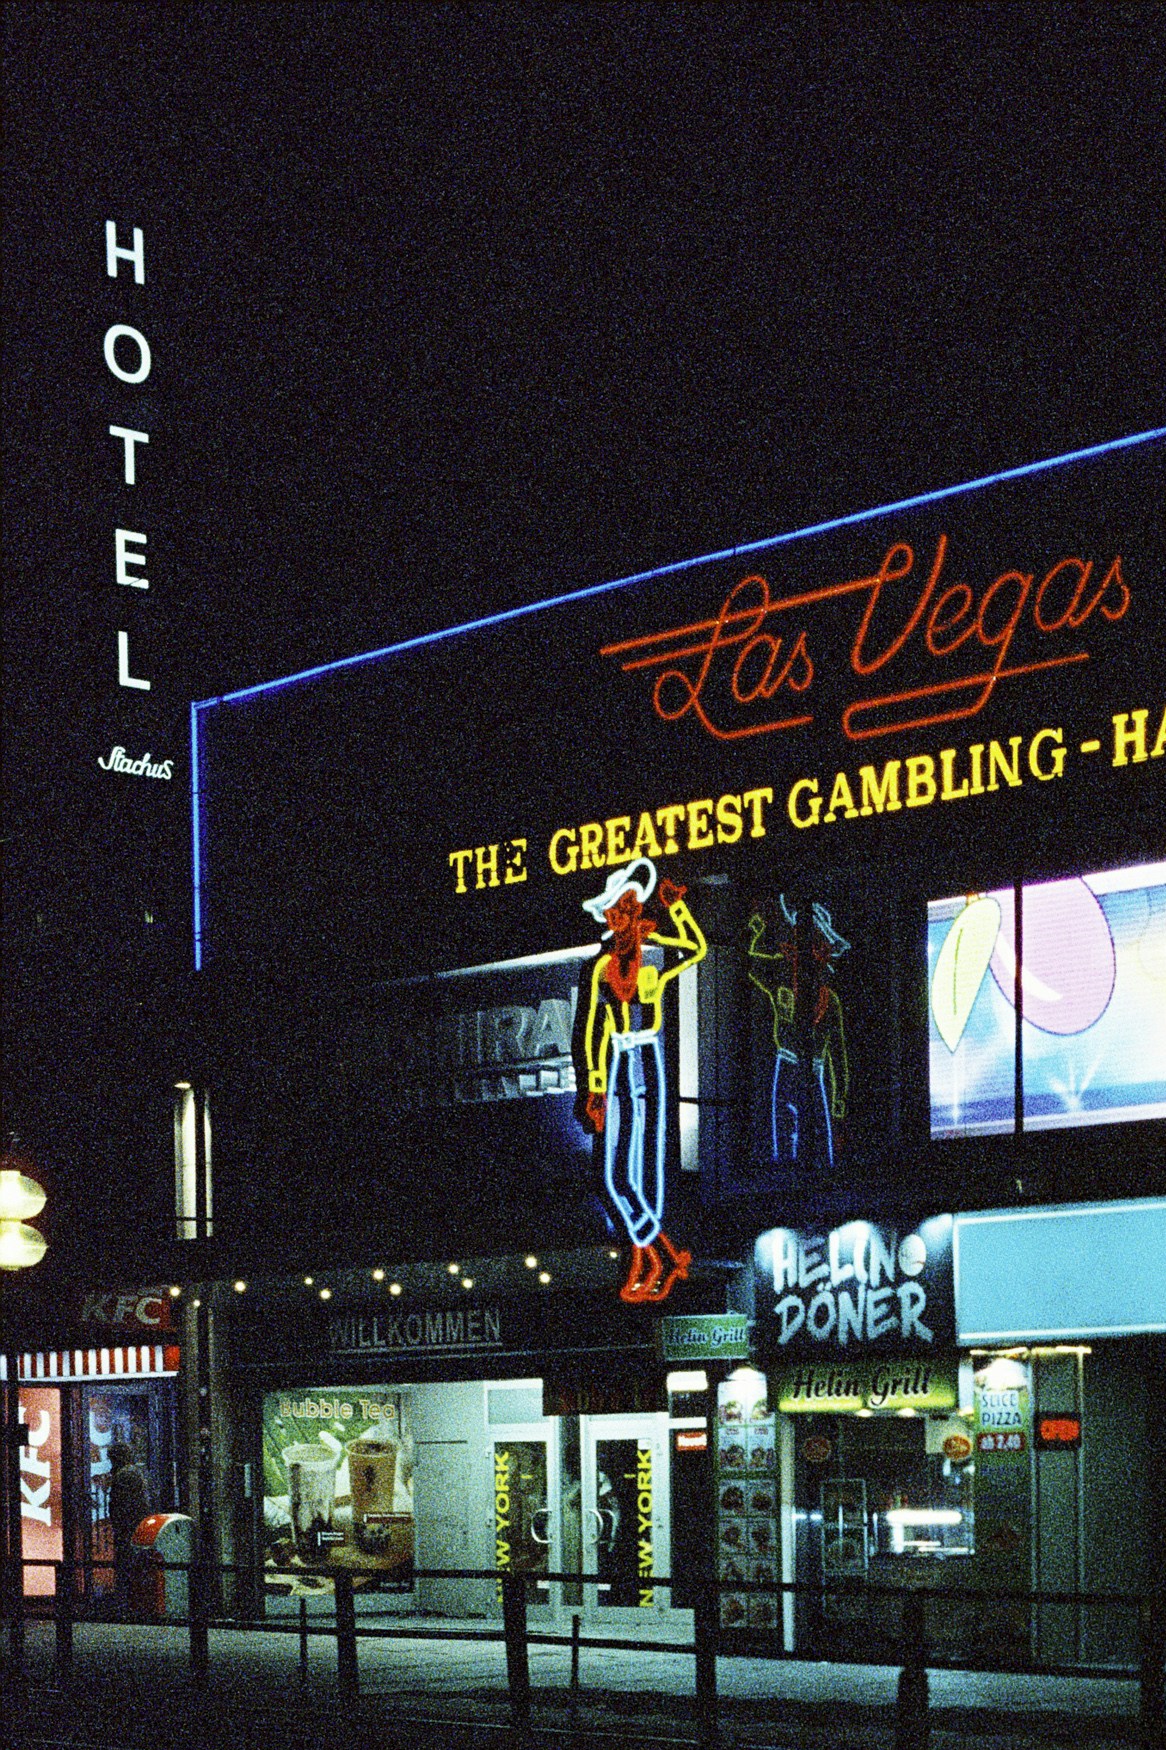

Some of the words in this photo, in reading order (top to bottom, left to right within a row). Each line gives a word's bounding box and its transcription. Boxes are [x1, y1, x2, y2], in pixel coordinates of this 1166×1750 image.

[103, 219, 152, 690] HOTEL
[606, 574, 813, 739] Las
[842, 535, 1131, 739] Vegas
[97, 745, 174, 780] Stachus
[448, 838, 528, 893] THE
[549, 787, 773, 875] GREATEST
[772, 1226, 897, 1294] HELIN
[80, 1293, 163, 1326] KFC
[330, 1309, 501, 1348] WILLKOMMEN
[773, 1281, 934, 1345] DÖNER
[278, 1397, 353, 1420] Bubble
[358, 1398, 397, 1421] Tea
[792, 1368, 860, 1399] Helin
[870, 1366, 931, 1405] Grill
[981, 1391, 1017, 1408] SLICE
[981, 1412, 1022, 1426] PIZZA
[18, 1401, 52, 1527] KFC
[494, 1450, 511, 1533] YORK
[636, 1449, 654, 1534] YORK
